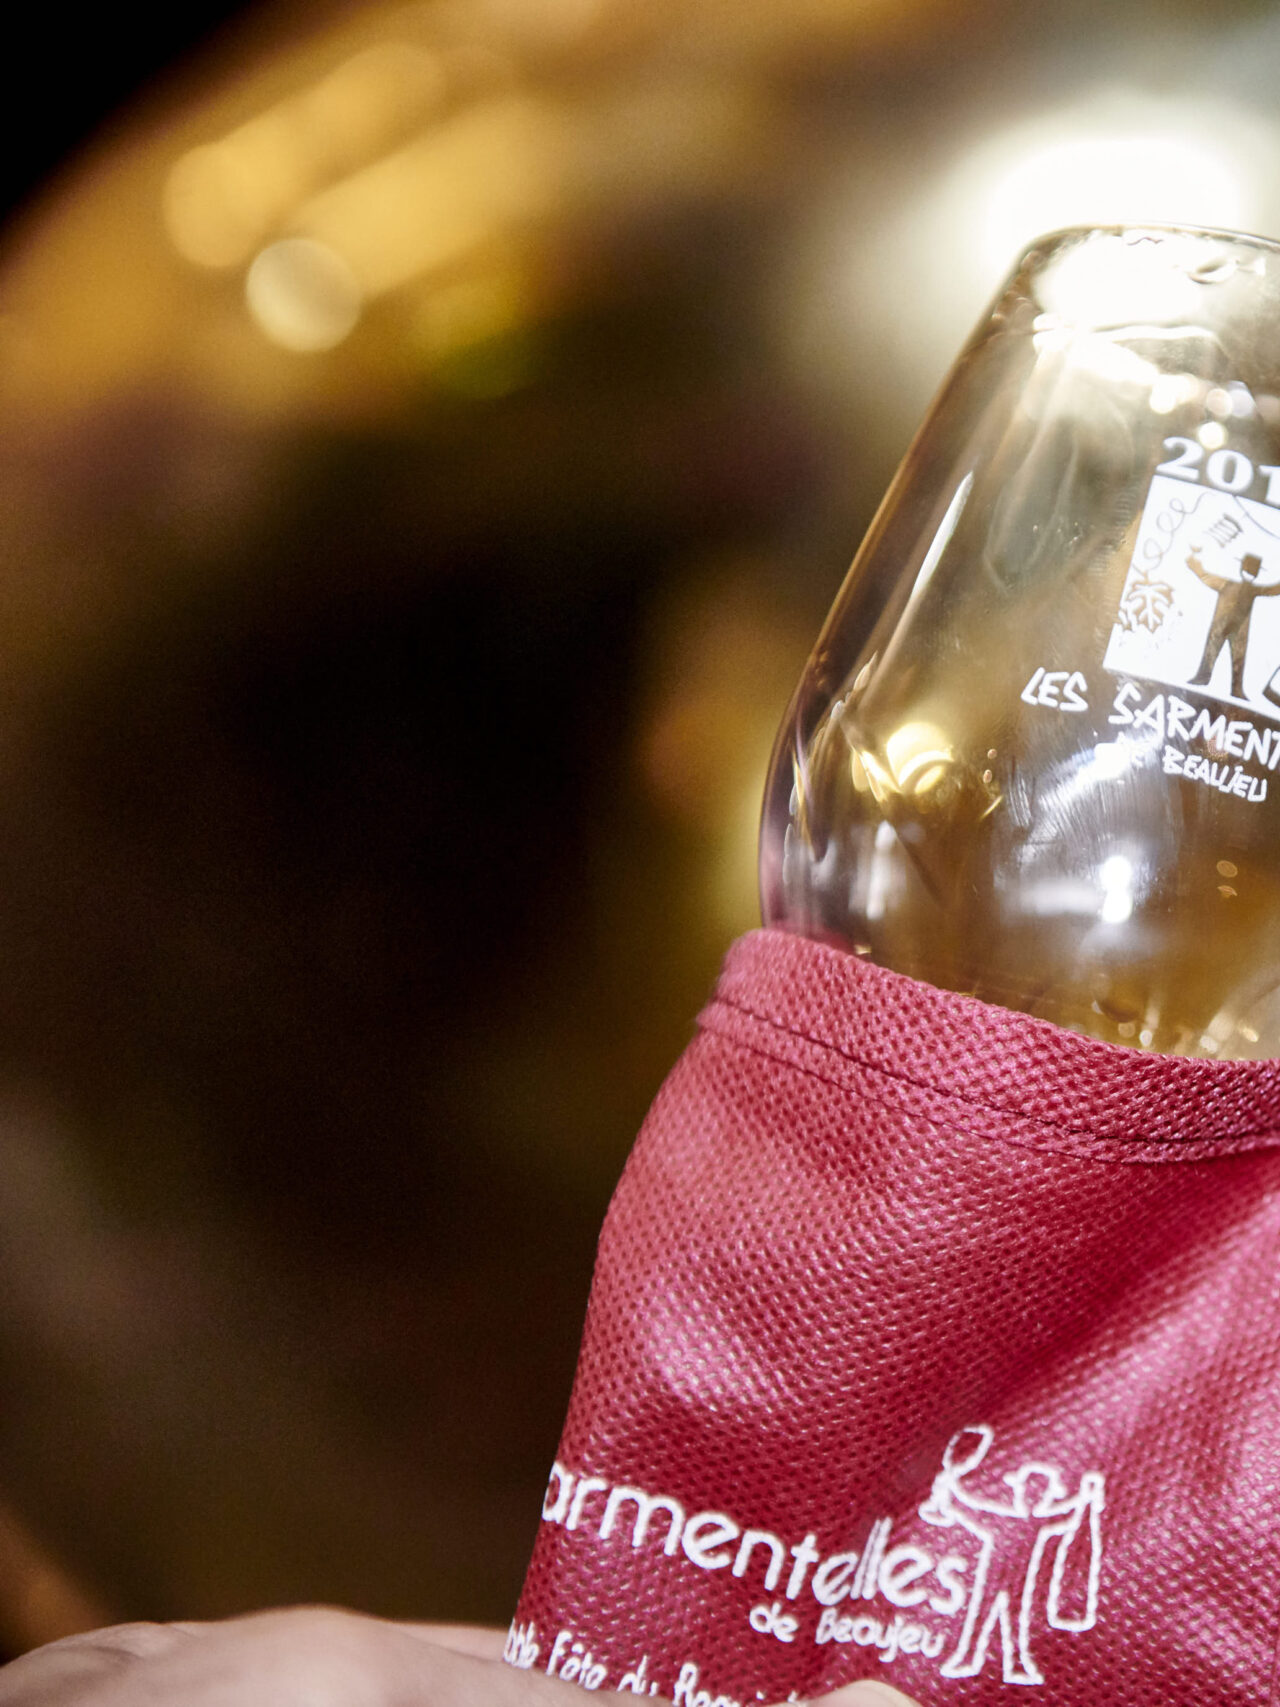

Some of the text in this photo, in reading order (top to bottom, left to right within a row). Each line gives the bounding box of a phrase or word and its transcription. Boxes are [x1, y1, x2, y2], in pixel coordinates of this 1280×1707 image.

[1020, 666, 1089, 712] LES
[1162, 744, 1268, 802] BEAUJEU
[748, 1601, 945, 1662] de Beaujeu
